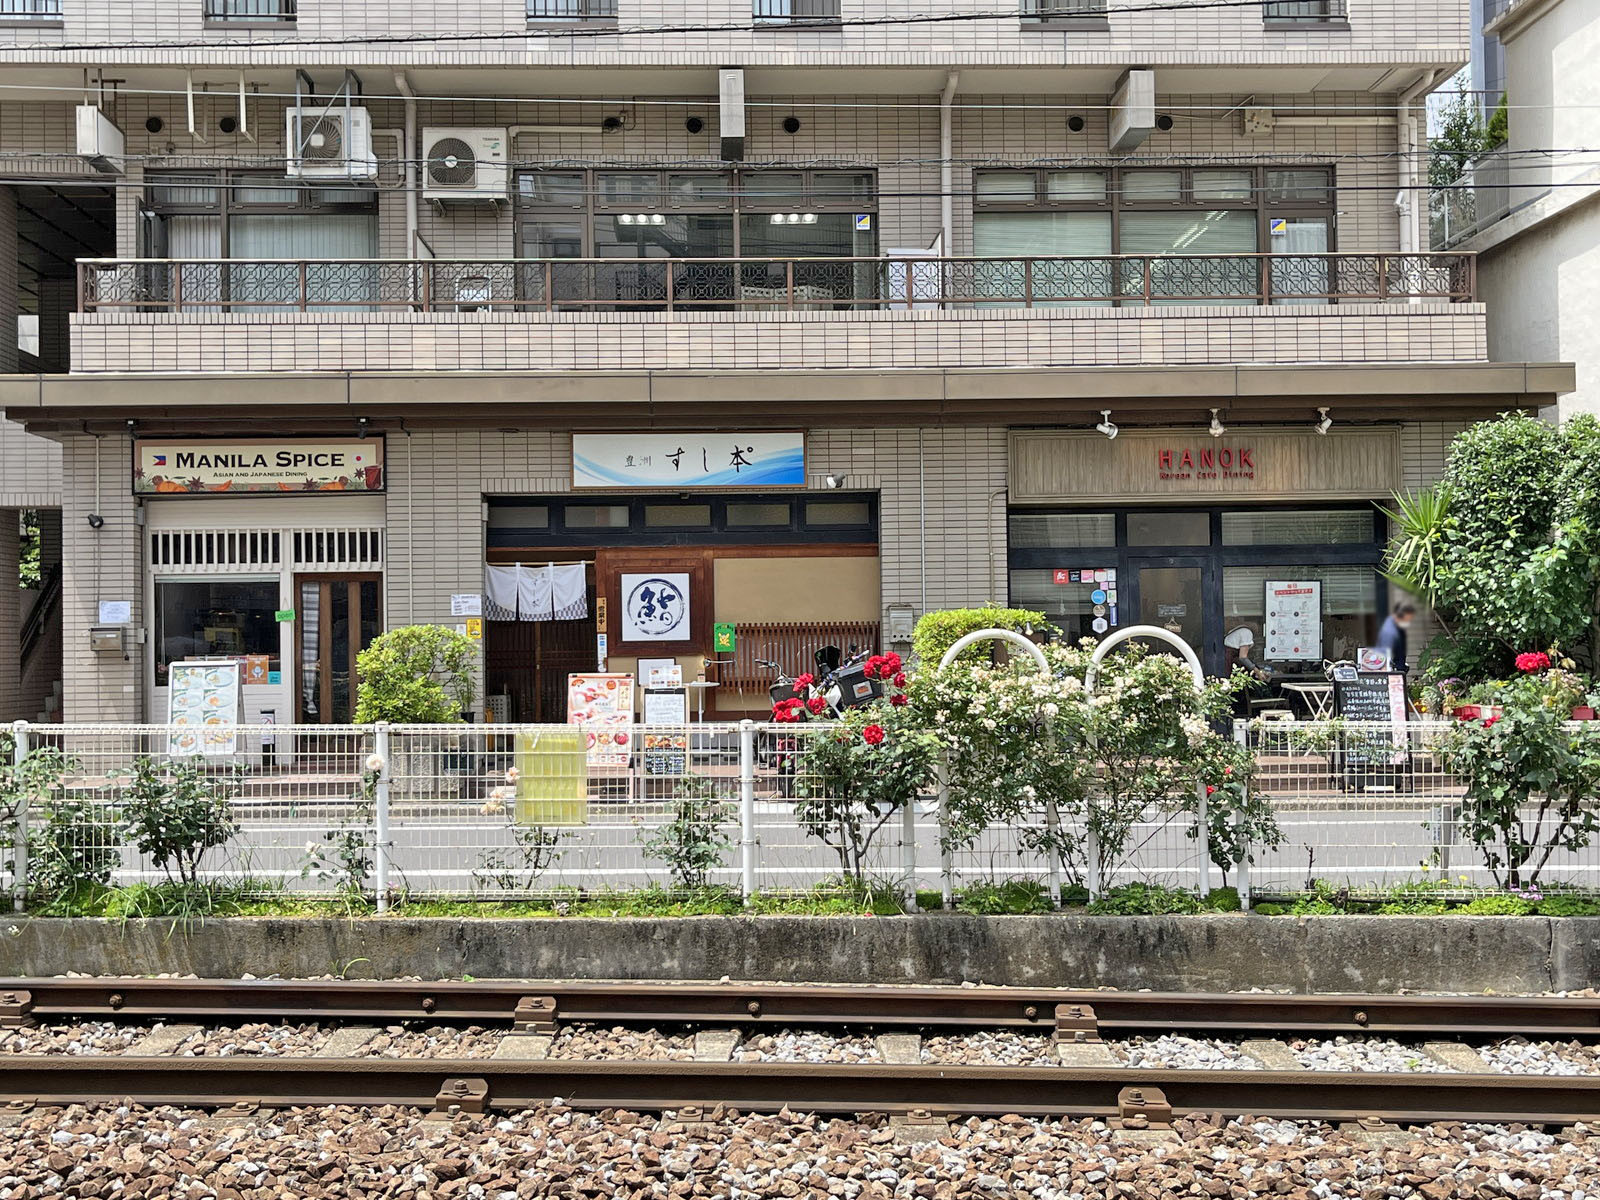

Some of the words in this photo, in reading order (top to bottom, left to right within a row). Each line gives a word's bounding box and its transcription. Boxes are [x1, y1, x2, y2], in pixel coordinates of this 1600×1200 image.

[176, 452, 269, 468] MANILA
[276, 451, 345, 467] SPICE
[1158, 448, 1255, 469] HANOK
[1223, 471, 1254, 480] Dining
